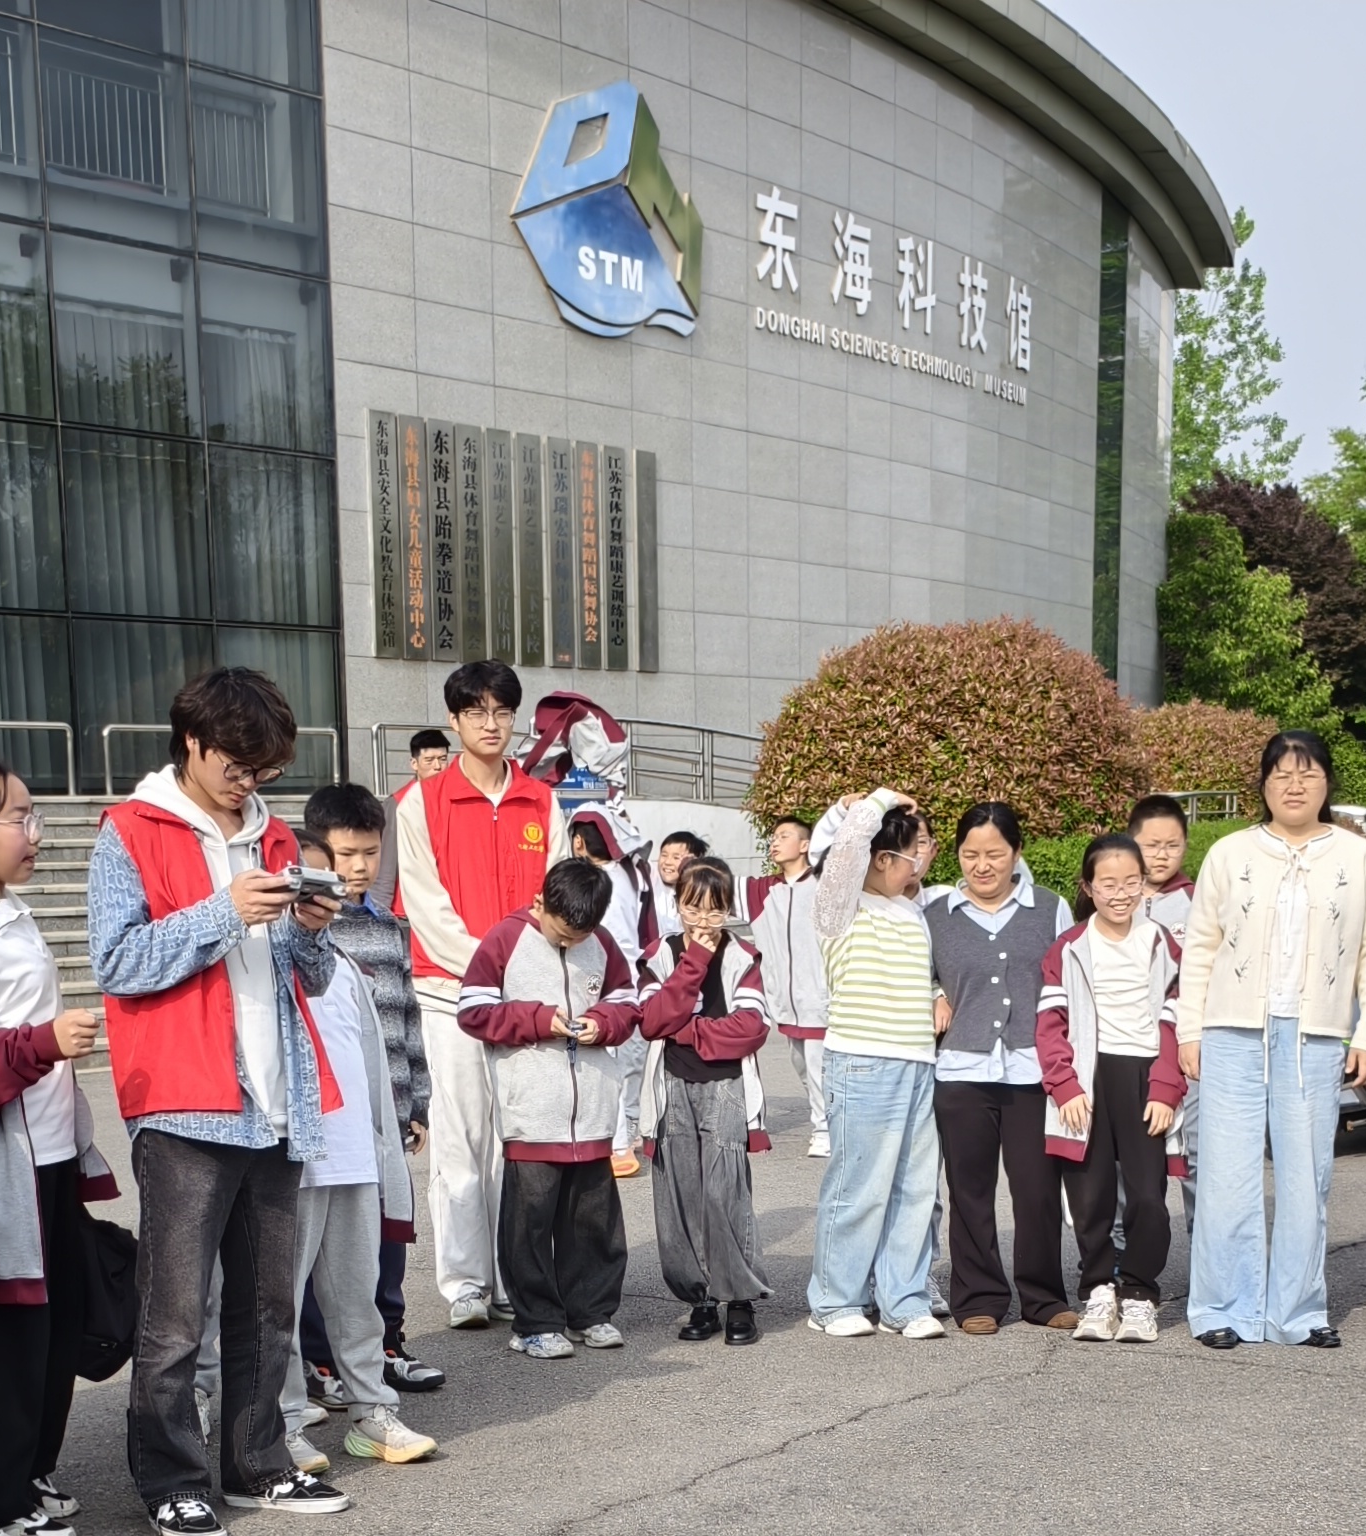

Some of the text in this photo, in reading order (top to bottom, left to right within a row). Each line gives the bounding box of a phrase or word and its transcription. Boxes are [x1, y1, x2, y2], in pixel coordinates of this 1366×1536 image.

[577, 245, 644, 293] STM
[755, 185, 1032, 373] 东海科技馆
[755, 306, 1027, 406] DONGHAI SCIENCE & TECHNOLOGY MUSEUM
[375, 419, 396, 649] 东海县安全文化教育体验馆
[404, 424, 426, 649] 东海县妇女儿童活动中心
[432, 429, 455, 651] 东海县跆拳道协会
[607, 455, 626, 647] 江苏省体育舞蹈康艺训练中心
